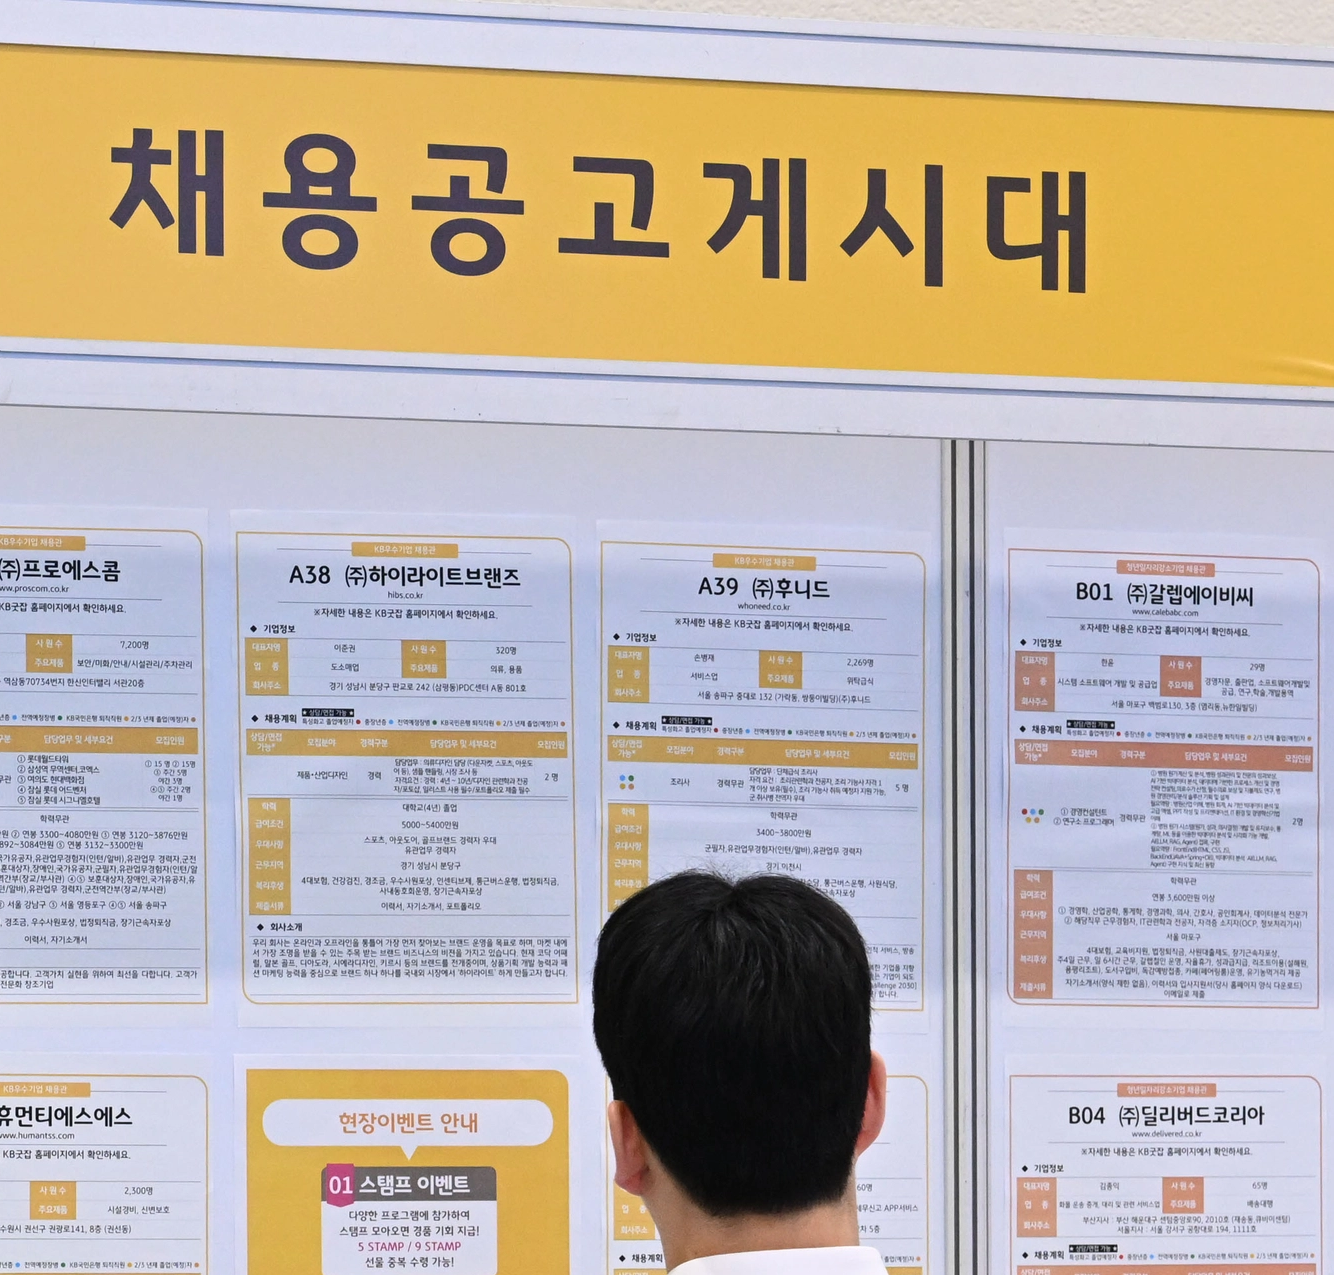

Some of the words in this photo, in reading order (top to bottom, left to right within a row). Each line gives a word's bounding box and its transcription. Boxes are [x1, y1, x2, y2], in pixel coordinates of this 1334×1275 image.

[109, 128, 1086, 293] 채용공고게시대
[290, 566, 330, 584] A38
[699, 577, 738, 595] A39
[1077, 582, 1113, 600] B01
[387, 590, 424, 600] hibs.co.kr
[737, 602, 791, 611] whoneed.co.kr
[1131, 608, 1199, 617] www.calebabc.com
[119, 640, 150, 650] 7,200명
[495, 646, 517, 656] 320명
[846, 658, 874, 668] 2,269명
[1249, 662, 1266, 672] 29명
[846, 676, 874, 686] 위탁급식
[401, 820, 459, 830] 5000~5400만원
[1069, 1107, 1105, 1124] B04
[339, 1113, 434, 1134] 현장이벤트
[441, 1113, 477, 1133] 안내
[1131, 1130, 1202, 1138] www.delivered.co.kr
[2, 1149, 32, 1160] KB굿잡
[34, 1149, 85, 1160] 홈페이지에서
[87, 1149, 131, 1160] 확인하세요.
[1034, 1164, 1064, 1174] 기업정보
[329, 1176, 353, 1194] 01
[359, 1175, 412, 1196] 스탬프
[418, 1175, 470, 1195] 이벤트
[1252, 1181, 1268, 1191] 65명
[124, 1186, 154, 1196] 2,300명
[1246, 1199, 1274, 1209] 배송대행
[348, 1210, 378, 1222] 다양한
[380, 1210, 429, 1222] 프로그램에
[431, 1209, 470, 1222] 참가하여
[339, 1226, 368, 1238] 스탬프
[371, 1225, 410, 1237] 모아오면
[413, 1225, 432, 1238] 경품
[435, 1225, 454, 1237] 기회
[457, 1225, 480, 1237] 지급!
[358, 1241, 365, 1252] 5
[367, 1241, 405, 1252] STAMP
[414, 1241, 422, 1252] 9
[424, 1241, 462, 1252] STAMP
[365, 1256, 384, 1269] 선물
[387, 1256, 407, 1269] 중복
[409, 1256, 429, 1268] 수령
[431, 1256, 454, 1268] 가능!
